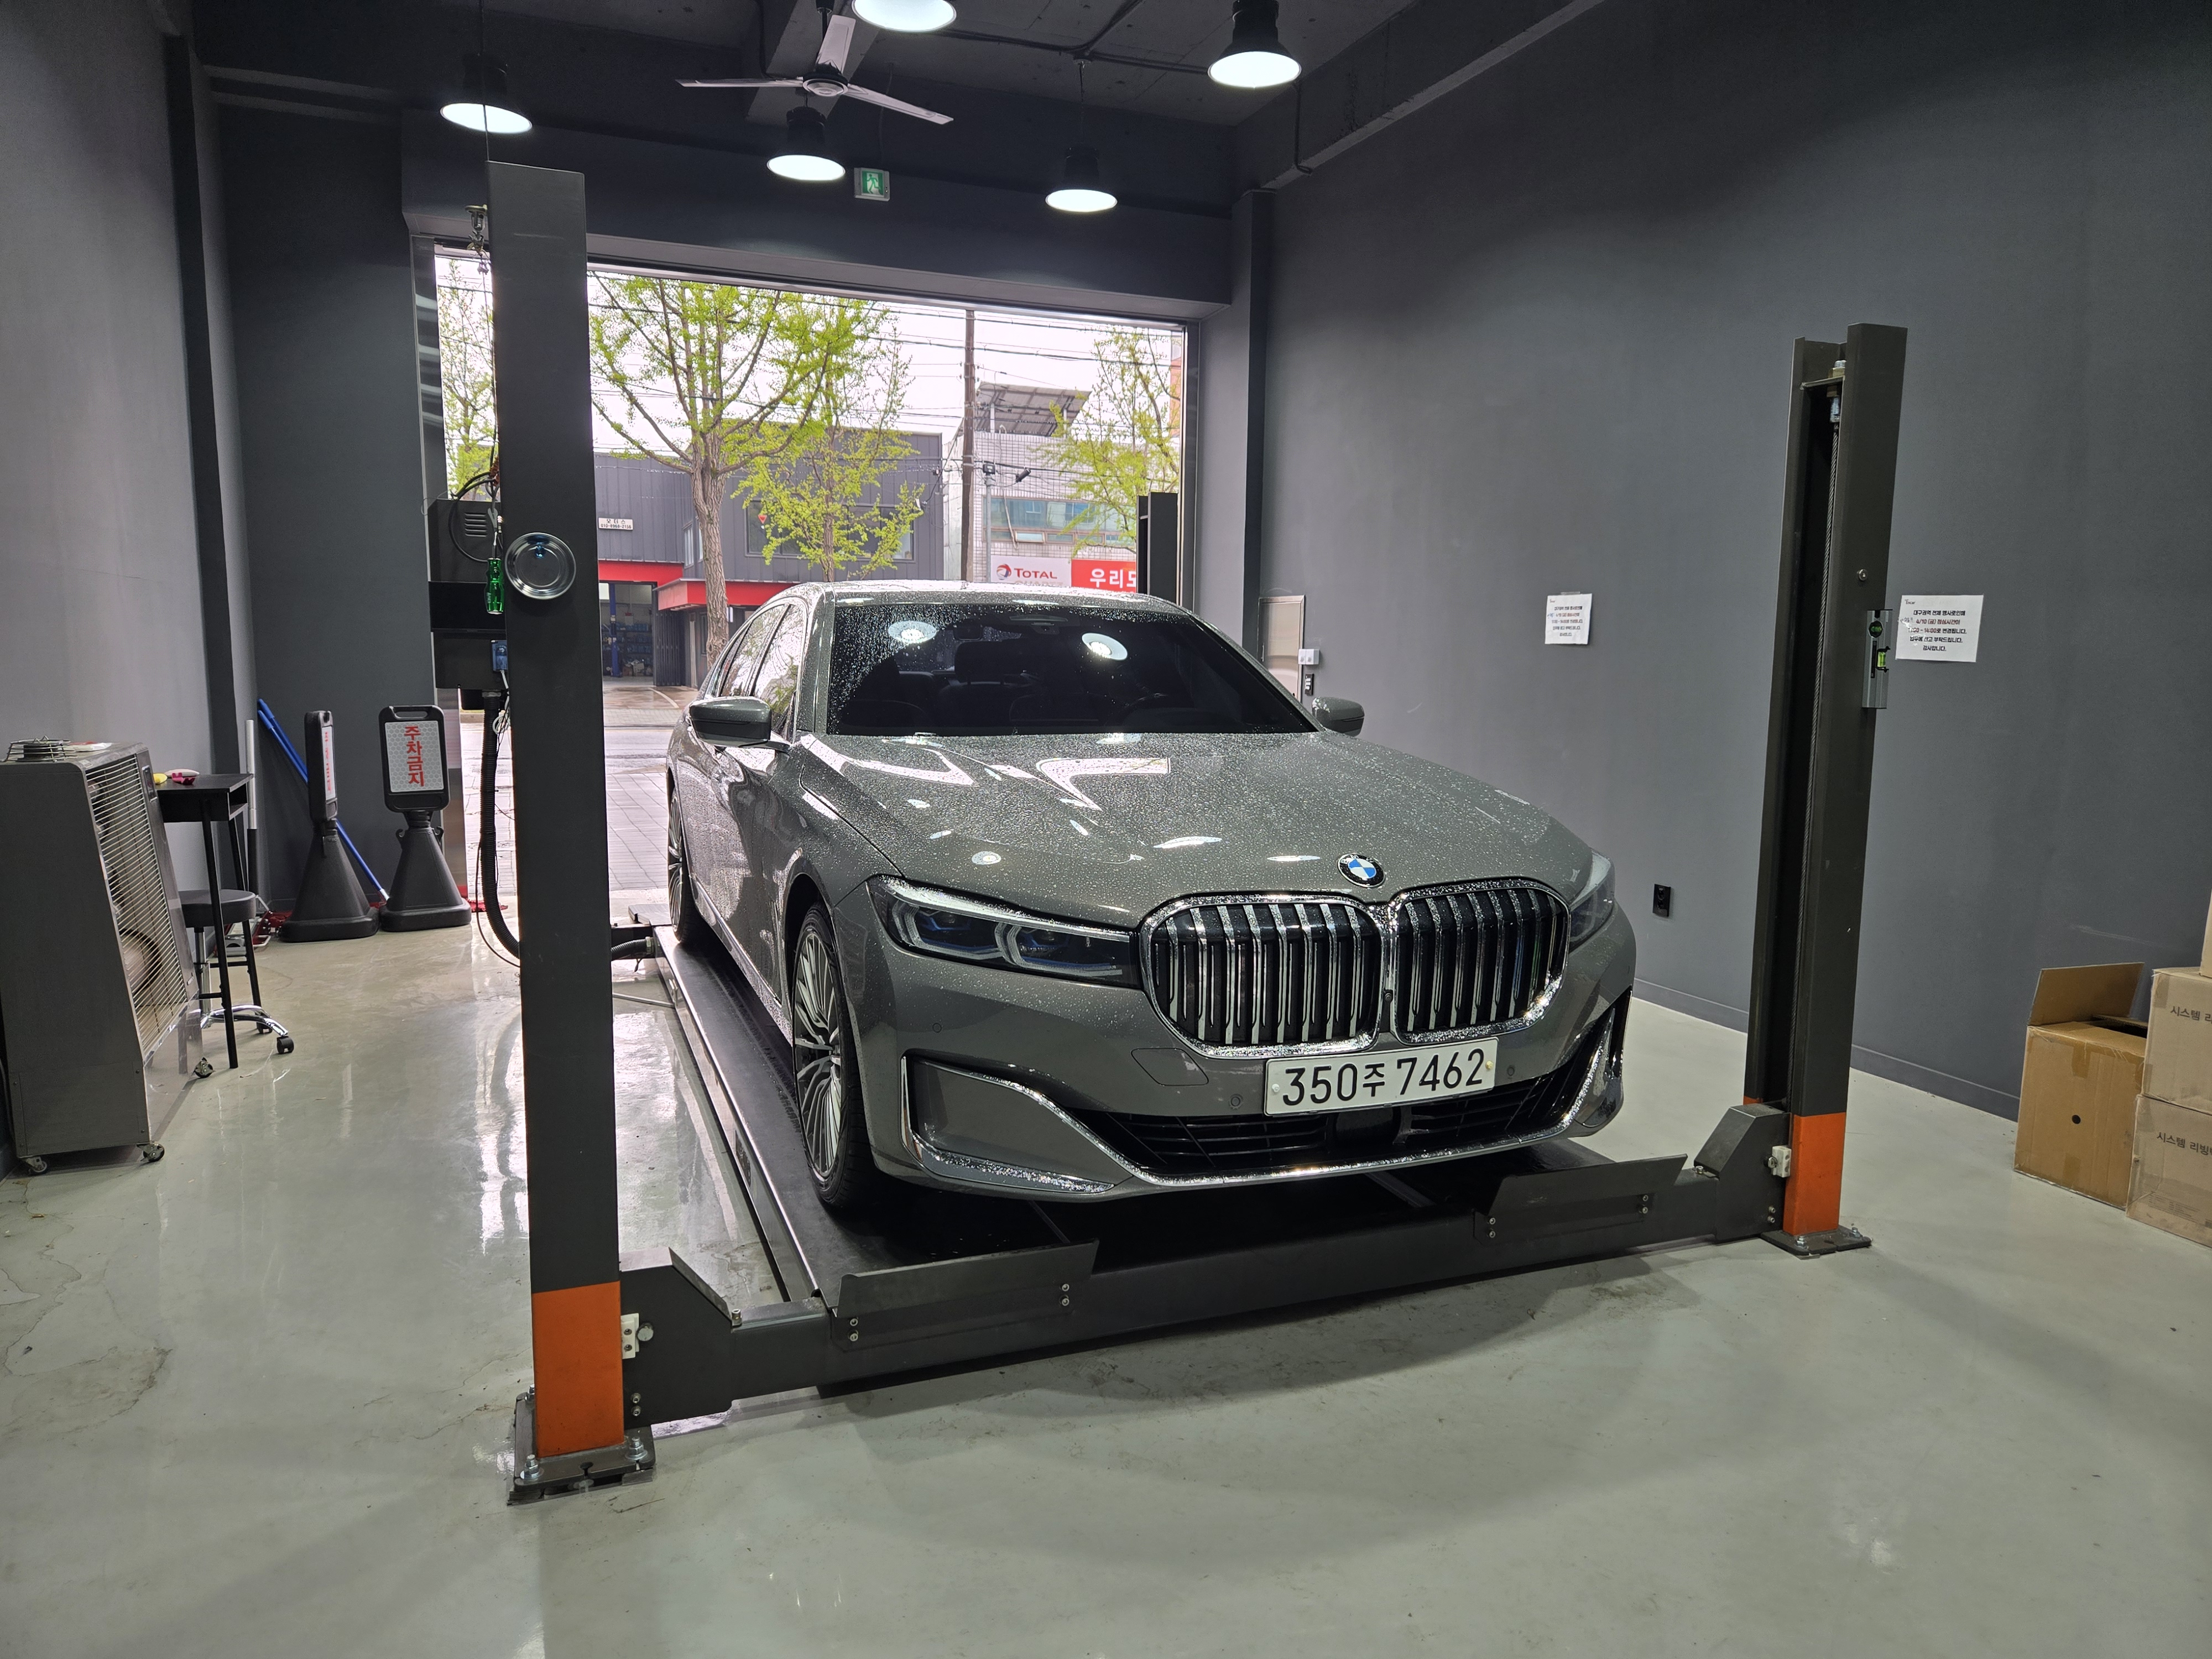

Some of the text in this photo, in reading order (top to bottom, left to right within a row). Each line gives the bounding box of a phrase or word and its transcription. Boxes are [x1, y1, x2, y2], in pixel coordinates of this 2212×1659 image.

[1014, 568, 1057, 579] TOTAL
[404, 726, 425, 787] 주차금지
[2170, 1006, 2200, 1021] 시스템
[1282, 1048, 1485, 1105] 350주 7462
[2157, 1132, 2185, 1149] 시스템
